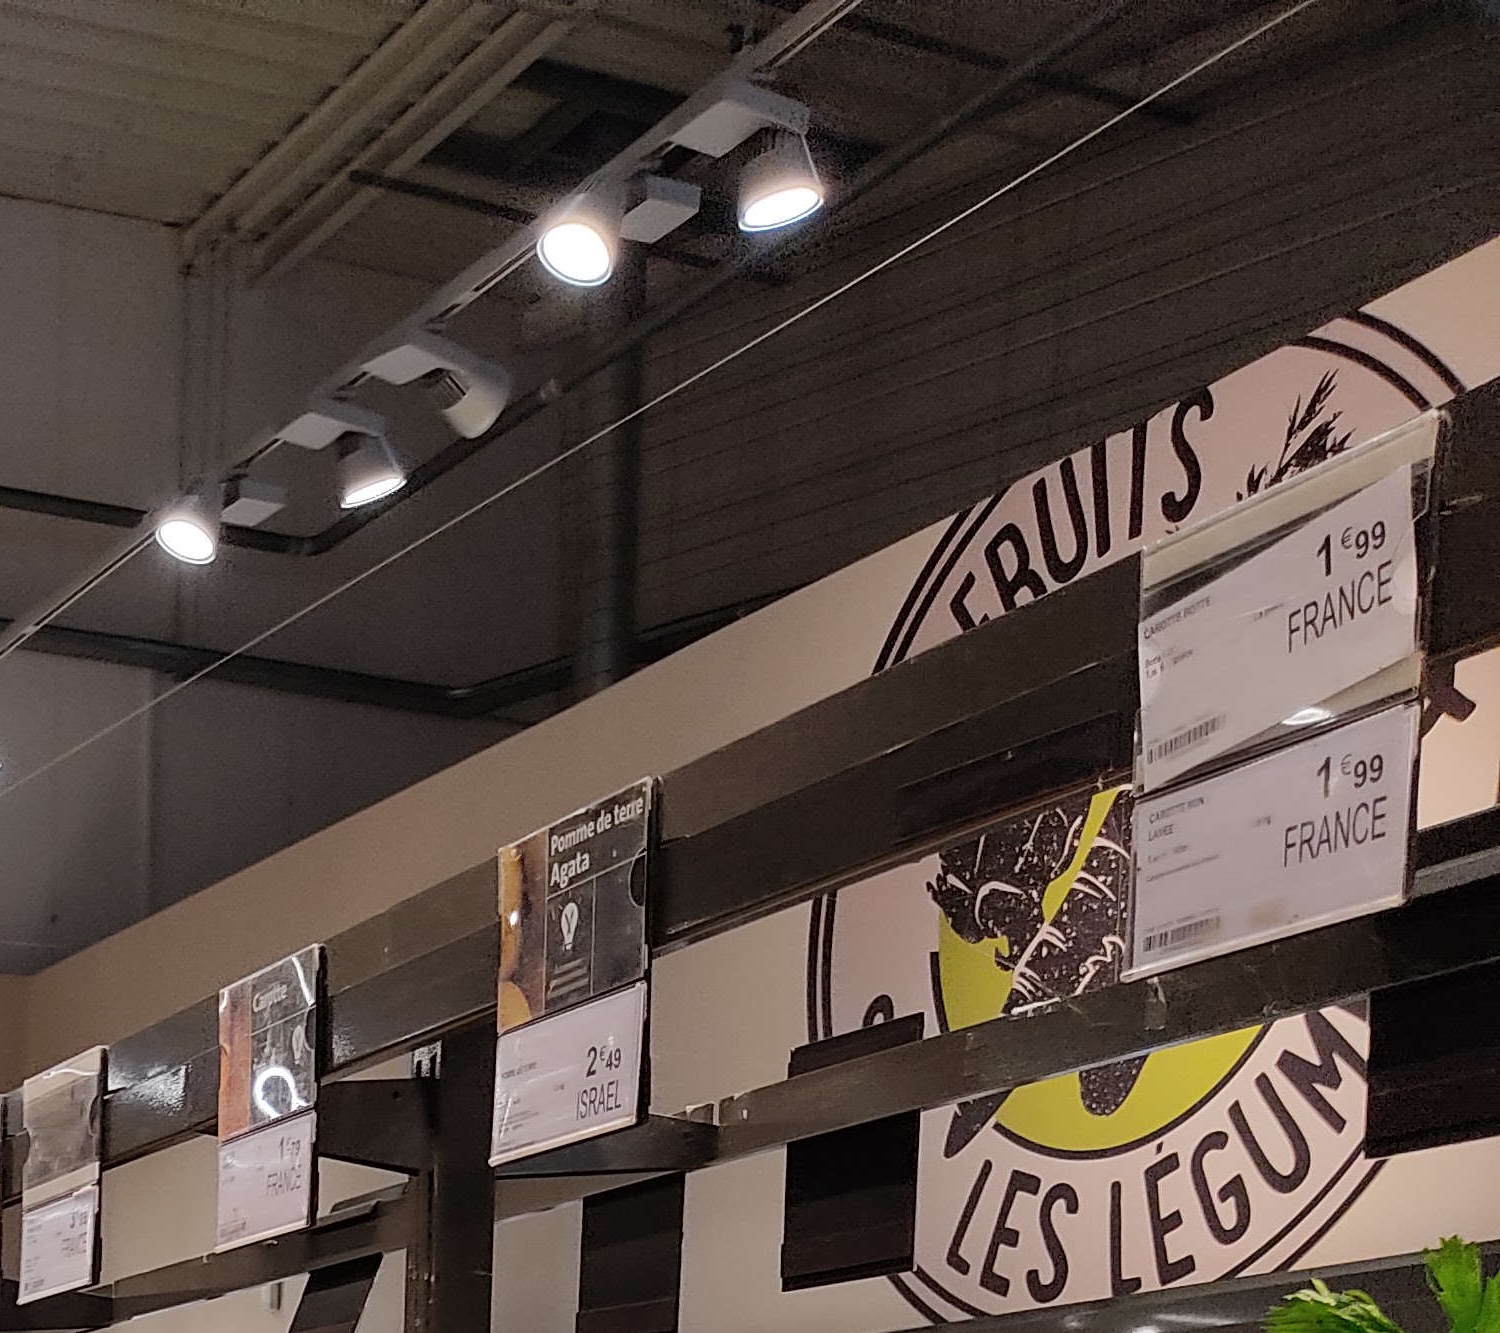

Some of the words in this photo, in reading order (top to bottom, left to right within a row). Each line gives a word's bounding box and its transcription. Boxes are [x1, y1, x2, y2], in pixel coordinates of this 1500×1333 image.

[1288, 560, 1393, 653] FRANCE
[551, 821, 595, 856] Pomme
[596, 809, 612, 834] de
[613, 797, 644, 825] terre
[1284, 796, 1388, 867] FRANCE
[550, 851, 590, 889] Agata
[576, 1080, 622, 1121] ISRAEL
[946, 1159, 1079, 1303] LES
[1109, 1005, 1368, 1297] LÉGUM
